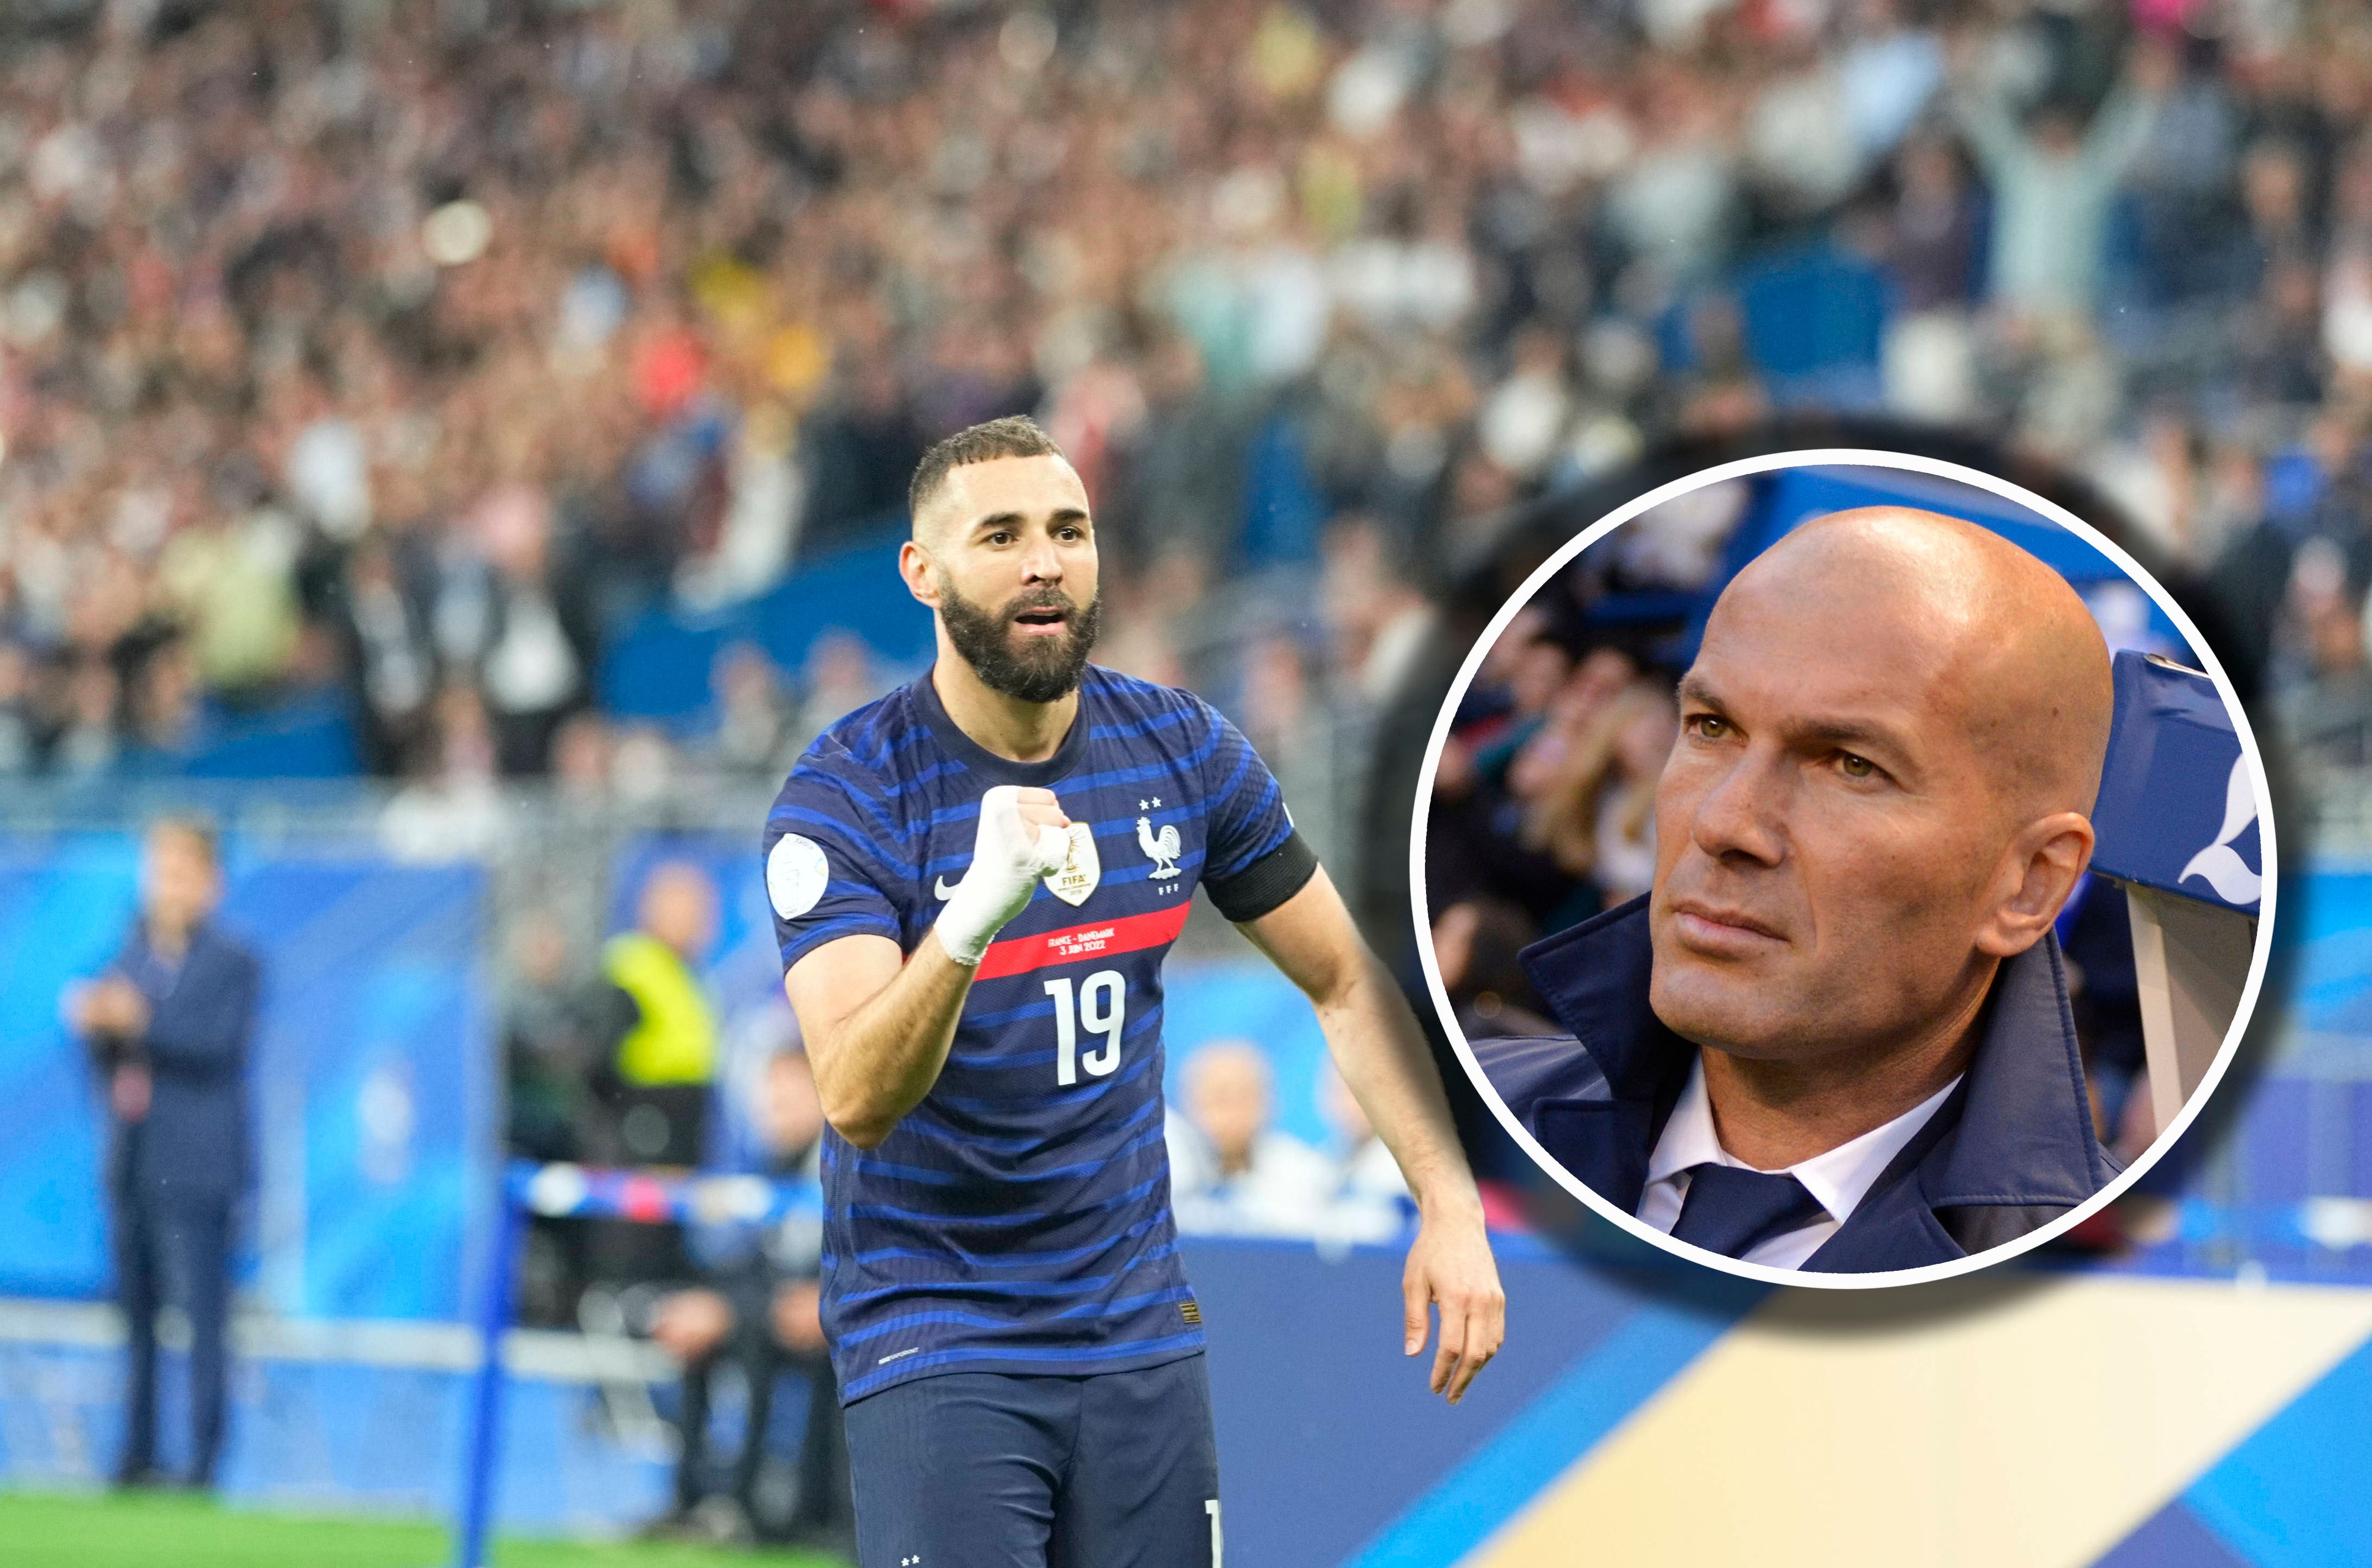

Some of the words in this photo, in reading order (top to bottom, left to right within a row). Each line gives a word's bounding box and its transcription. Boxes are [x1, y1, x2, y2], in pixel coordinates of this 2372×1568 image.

[1062, 874, 1085, 885] FIFA
[1059, 946, 1067, 955] 3
[1083, 939, 1106, 951] 2022
[1044, 970, 1126, 1086] 19
